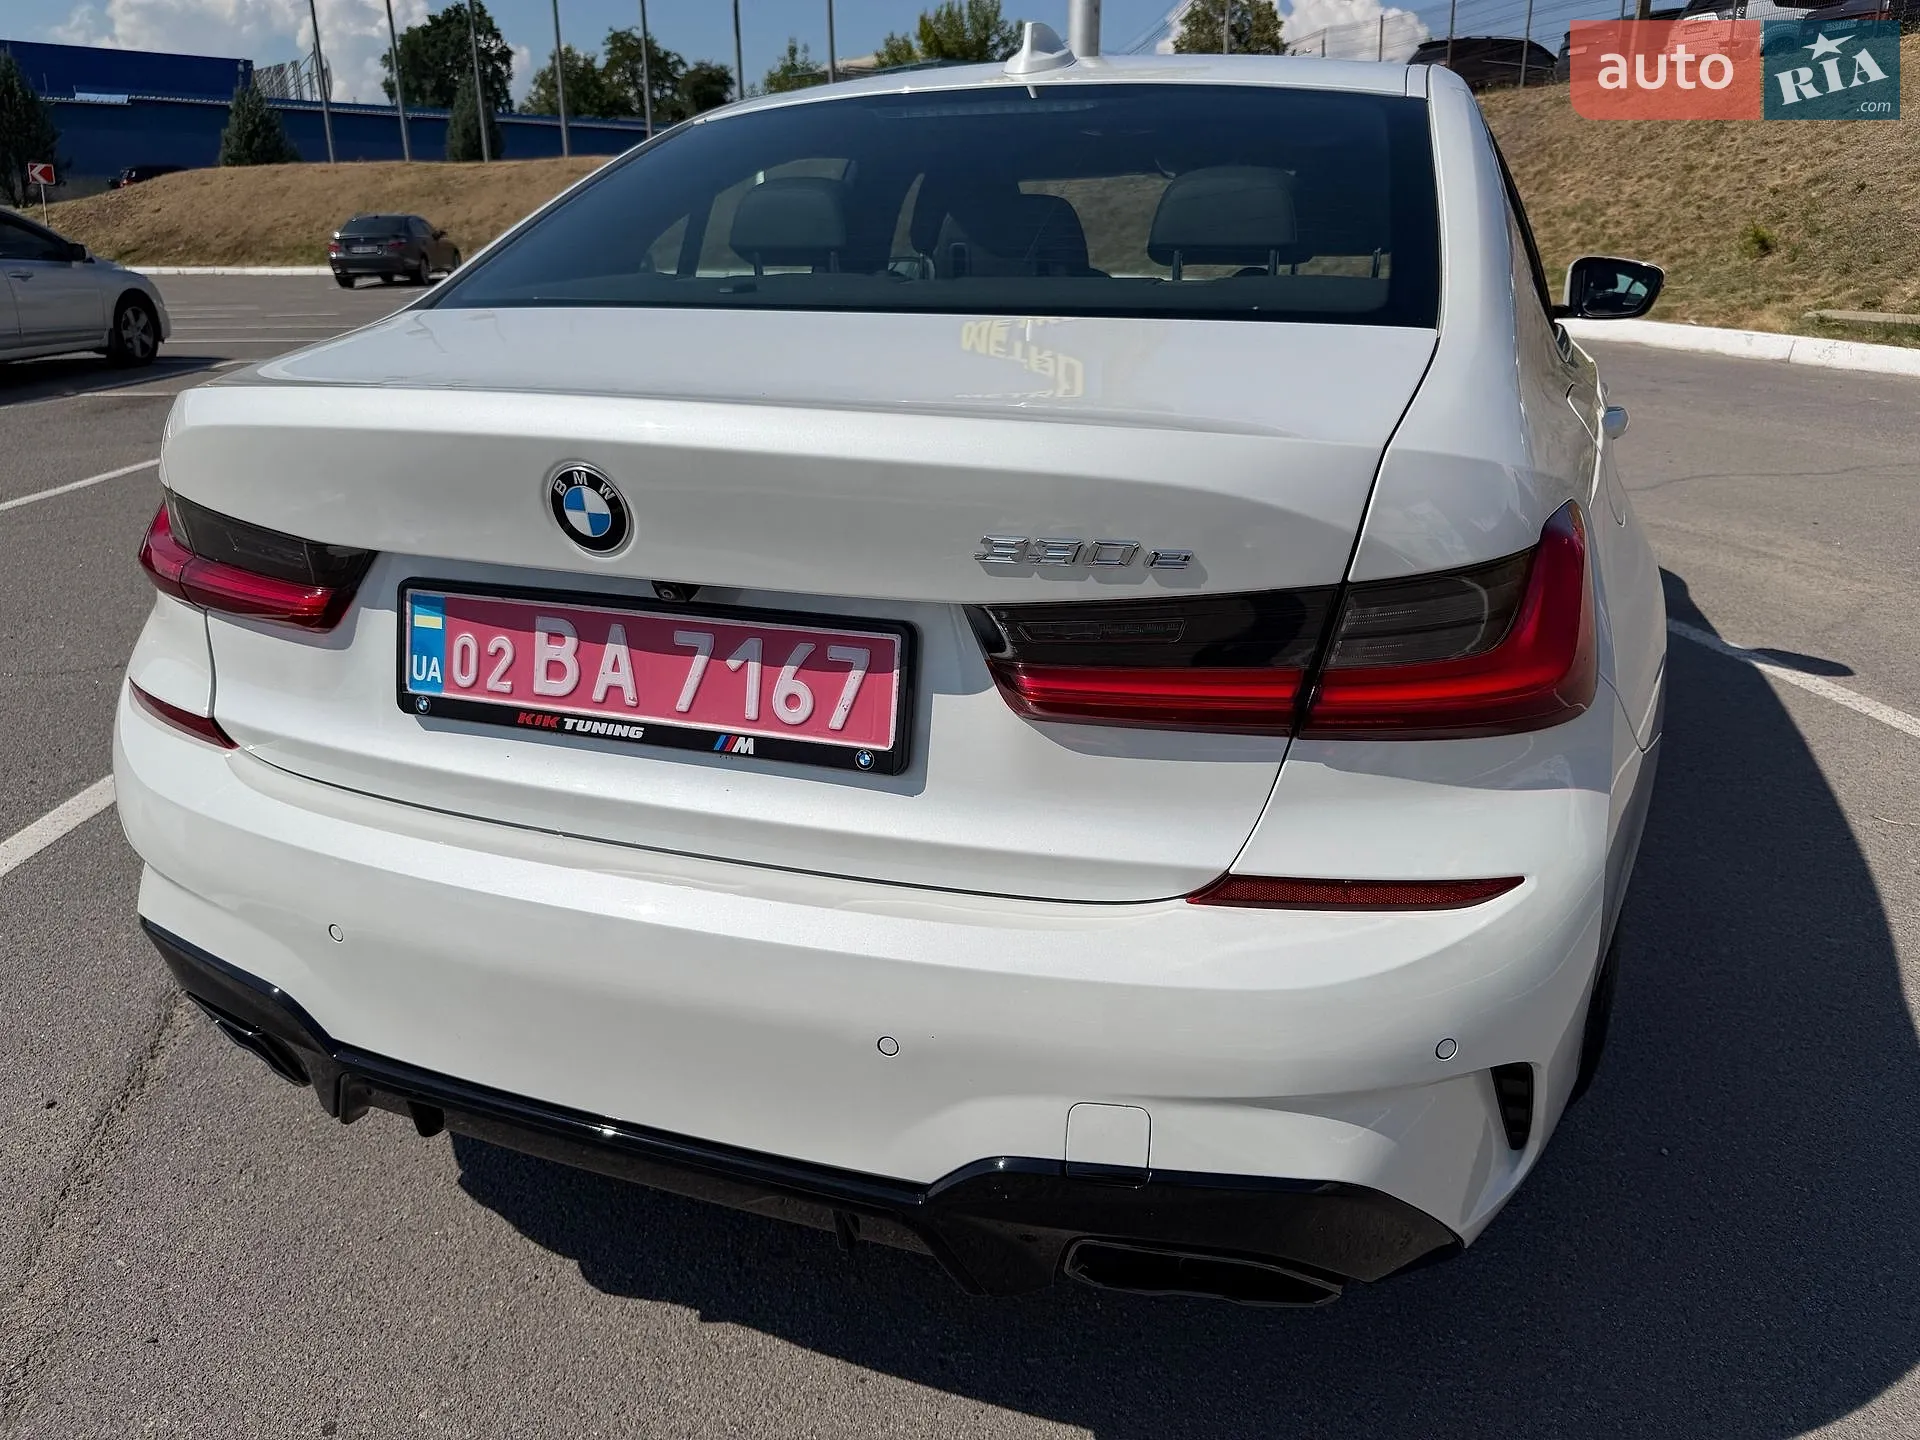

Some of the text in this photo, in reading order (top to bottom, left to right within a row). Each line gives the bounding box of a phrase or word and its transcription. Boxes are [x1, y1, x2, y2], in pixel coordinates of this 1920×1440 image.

[553, 470, 616, 501] BMW
[411, 654, 443, 684] UA
[452, 615, 871, 731] 02 BA 7167
[517, 711, 645, 740] KIK TUNING
